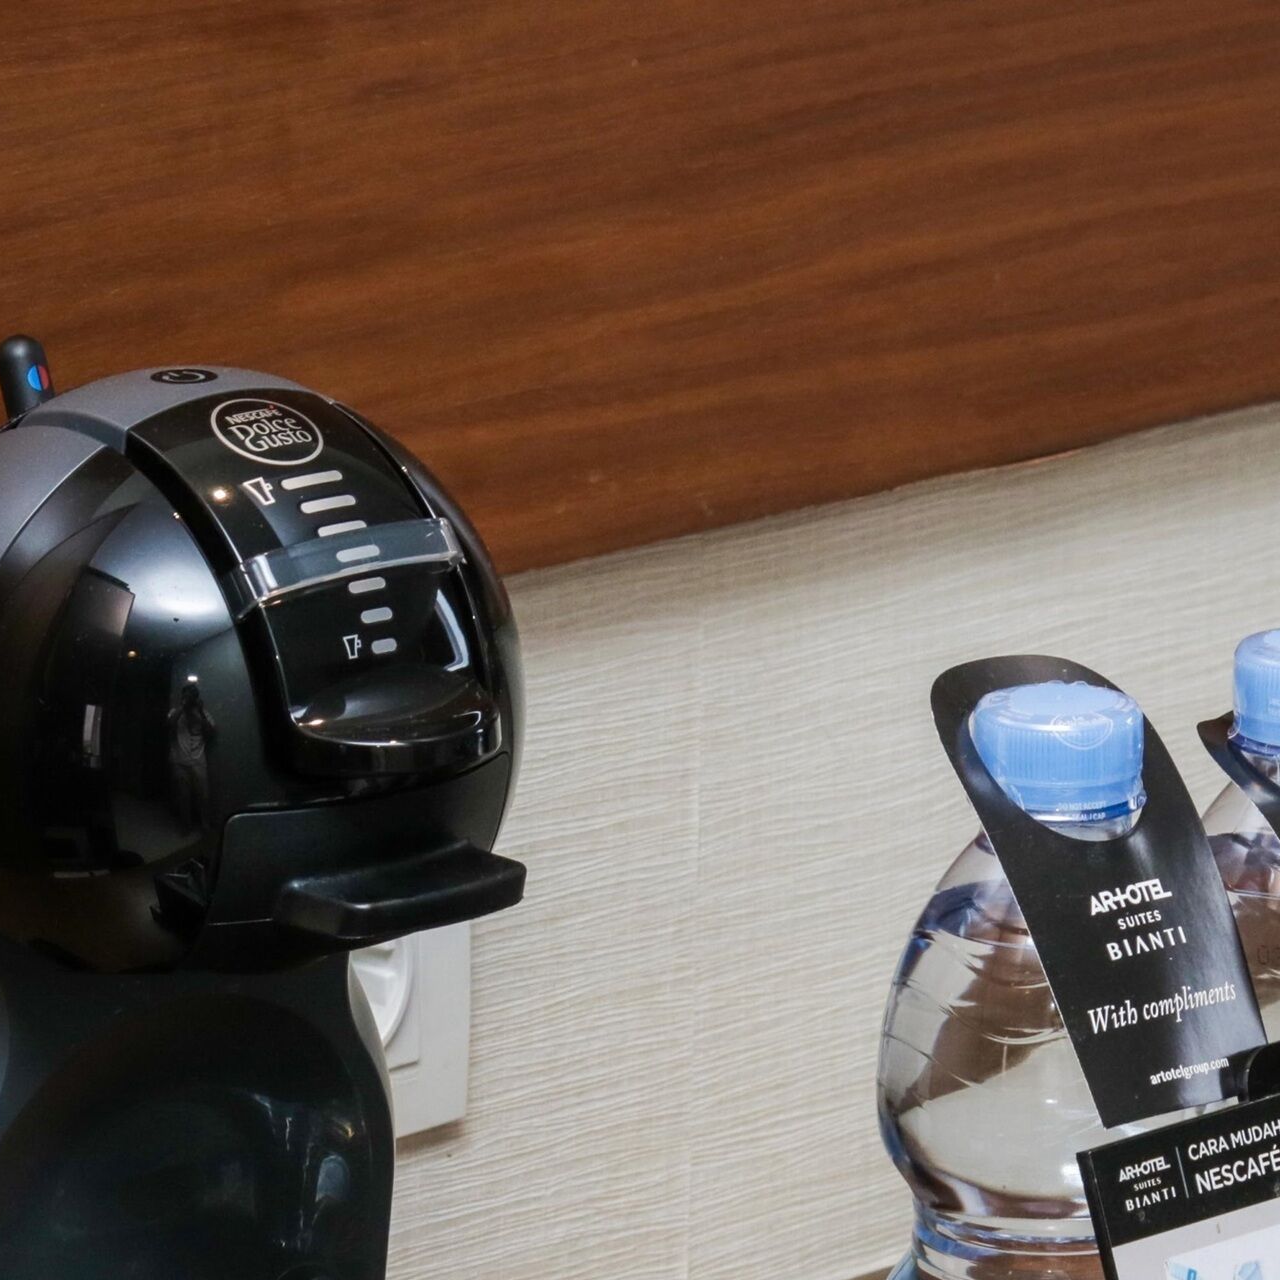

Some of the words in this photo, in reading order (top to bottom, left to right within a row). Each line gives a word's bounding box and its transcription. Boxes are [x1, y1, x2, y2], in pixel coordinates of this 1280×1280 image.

[228, 417, 302, 441] Dolce
[245, 429, 313, 452] Gusto
[1117, 909, 1162, 930] SUITES
[1106, 926, 1187, 961] BIANTI
[1087, 1000, 1138, 1034] With
[1143, 981, 1237, 1023] compliments
[1150, 1057, 1229, 1085] artotelgroup.com
[1188, 1136, 1230, 1161] CARA
[1133, 1177, 1162, 1191] SUITES
[1125, 1186, 1177, 1211] BIANTI
